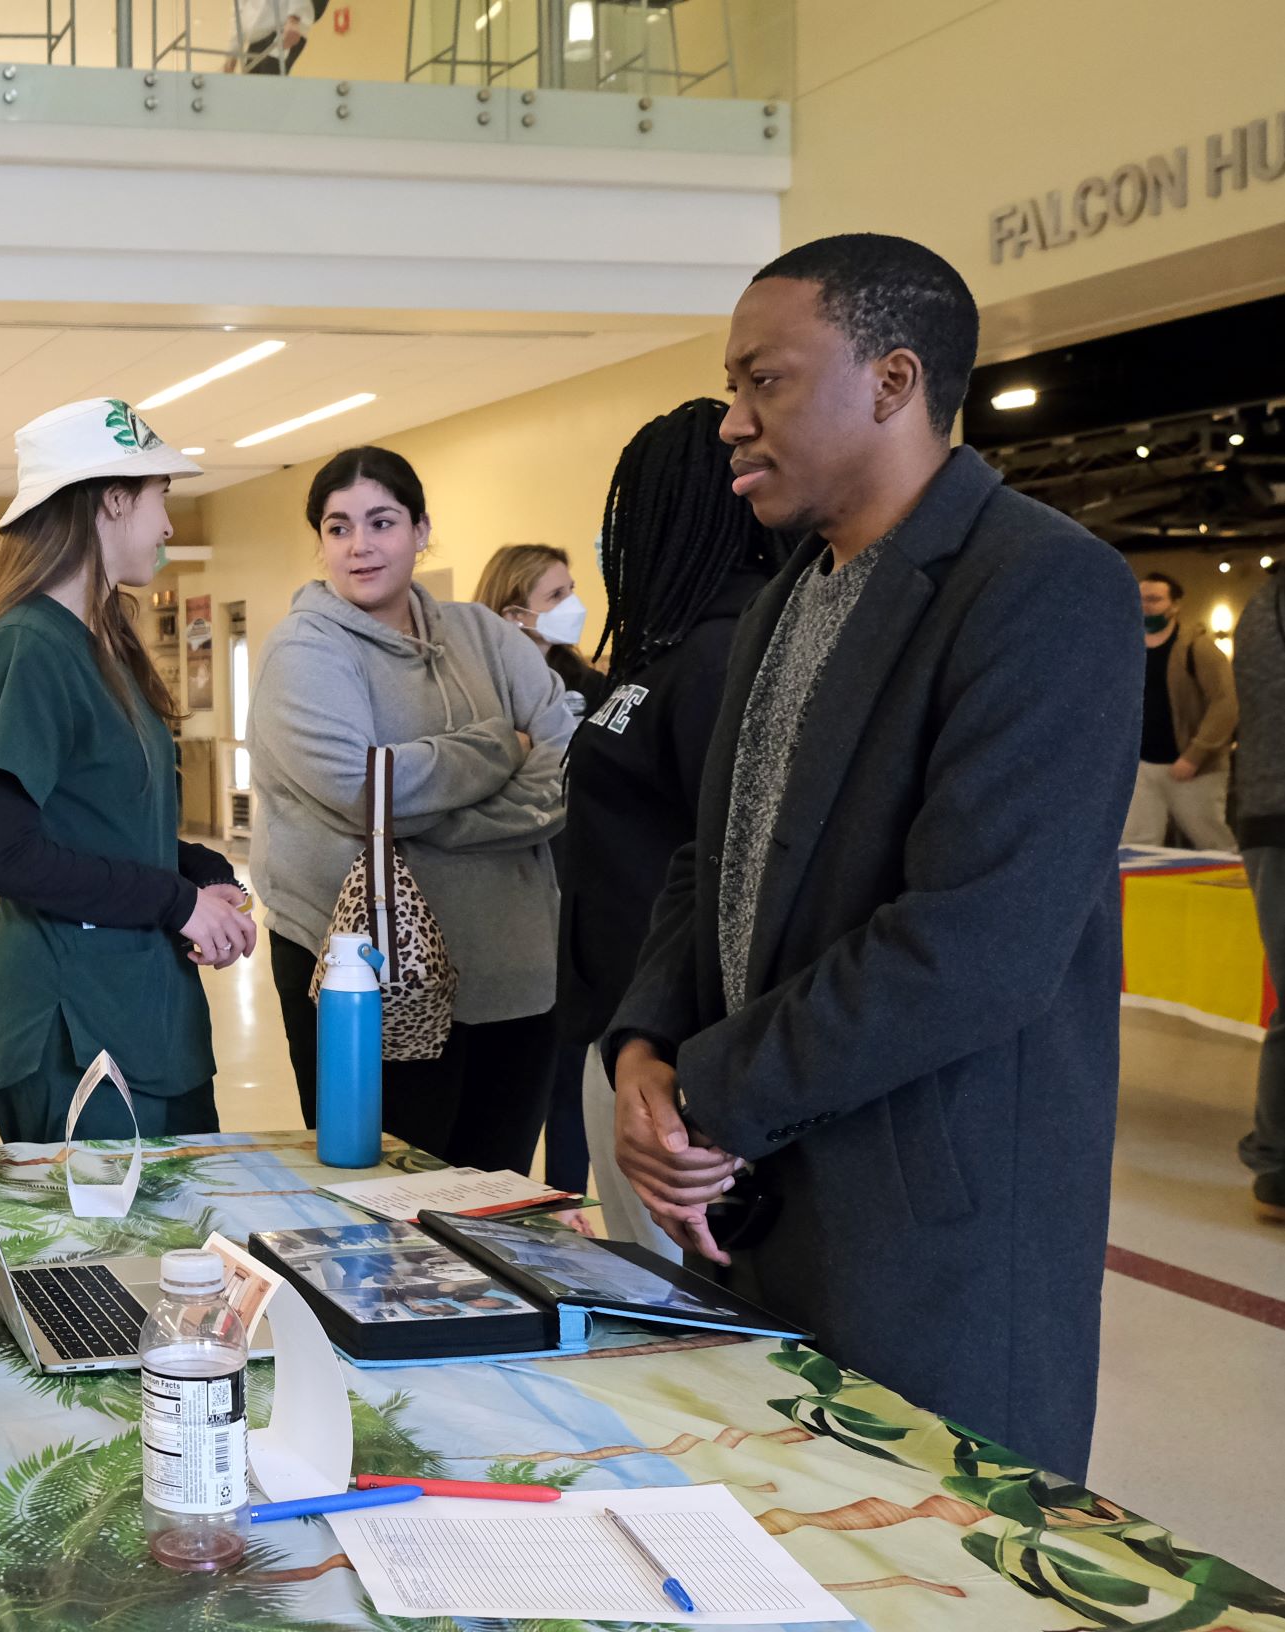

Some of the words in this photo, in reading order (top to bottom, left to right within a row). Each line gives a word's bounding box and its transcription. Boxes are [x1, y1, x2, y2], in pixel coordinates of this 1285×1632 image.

[988, 145, 1188, 266] FALCON
[161, 1381, 180, 1389] Facts
[175, 1403, 181, 1413] 0
